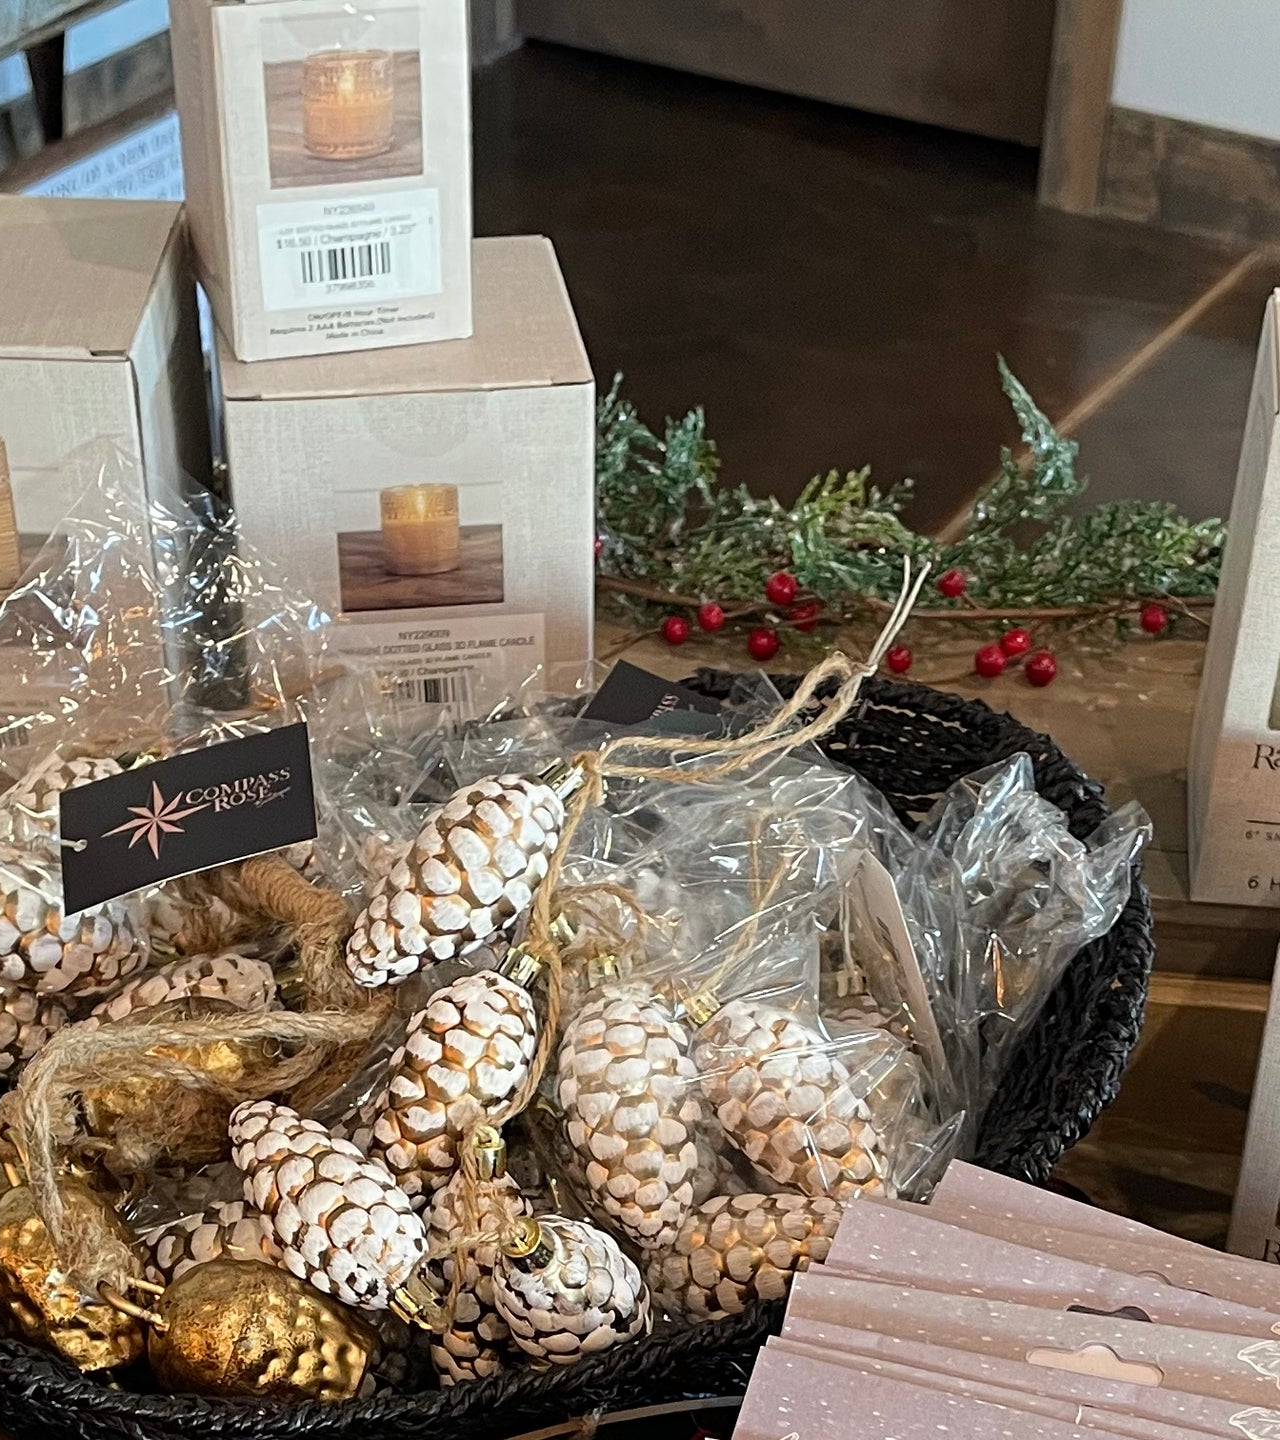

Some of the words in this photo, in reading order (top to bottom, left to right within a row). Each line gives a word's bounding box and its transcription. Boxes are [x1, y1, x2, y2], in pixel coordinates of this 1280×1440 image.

[185, 766, 292, 805] COMPASS
[214, 785, 272, 813] ROSE
[1247, 875, 1260, 890] 6
